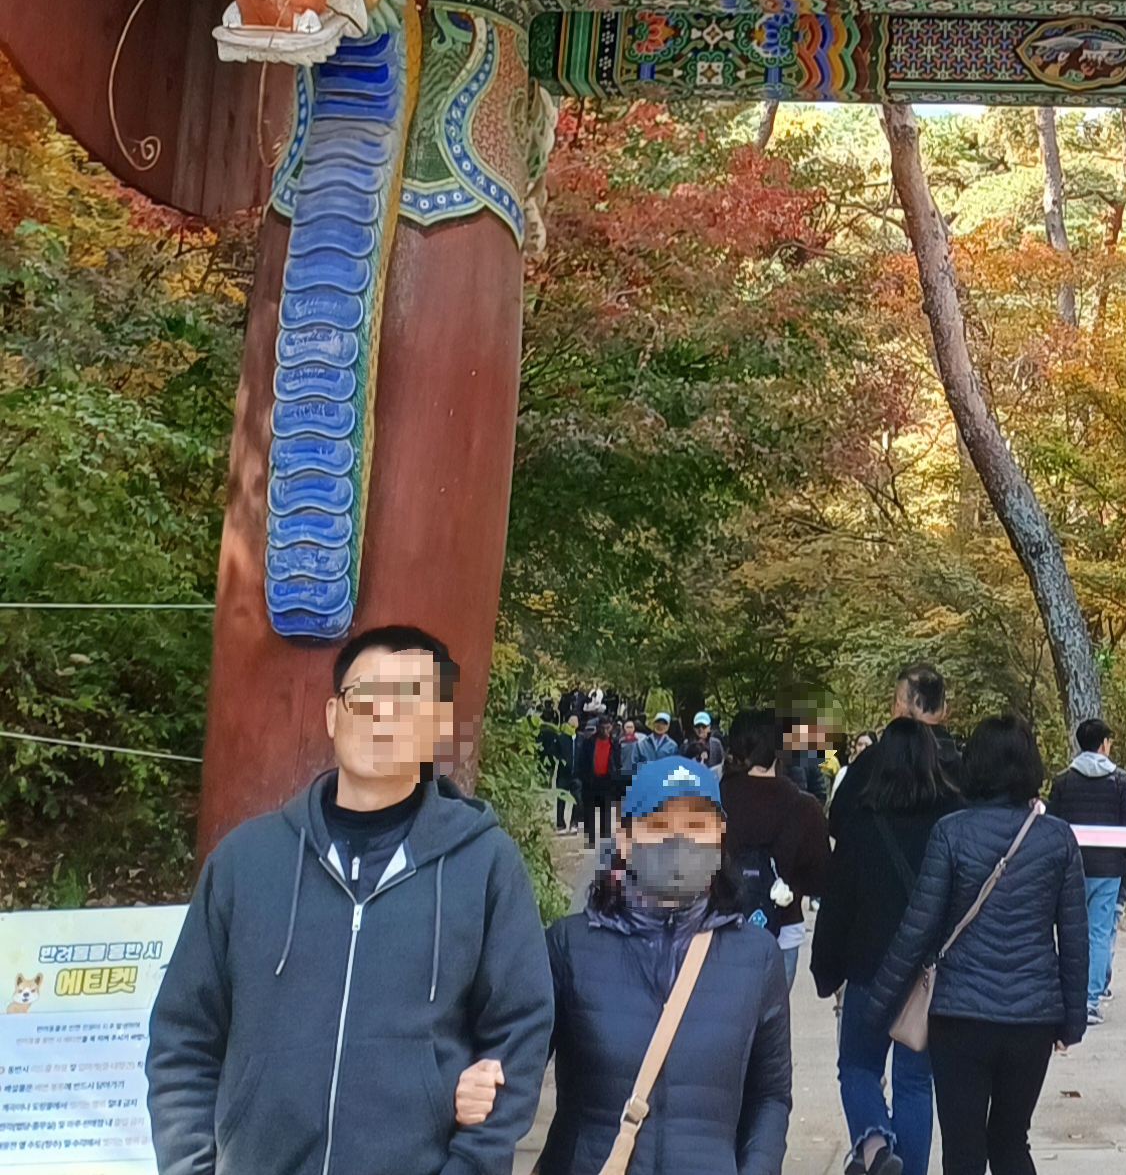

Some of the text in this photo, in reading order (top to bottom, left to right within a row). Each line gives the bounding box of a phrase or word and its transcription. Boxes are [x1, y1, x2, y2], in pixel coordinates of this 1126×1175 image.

[39, 943, 107, 963] 반려동물
[145, 941, 162, 959] 시
[54, 966, 138, 996] 에티켓
